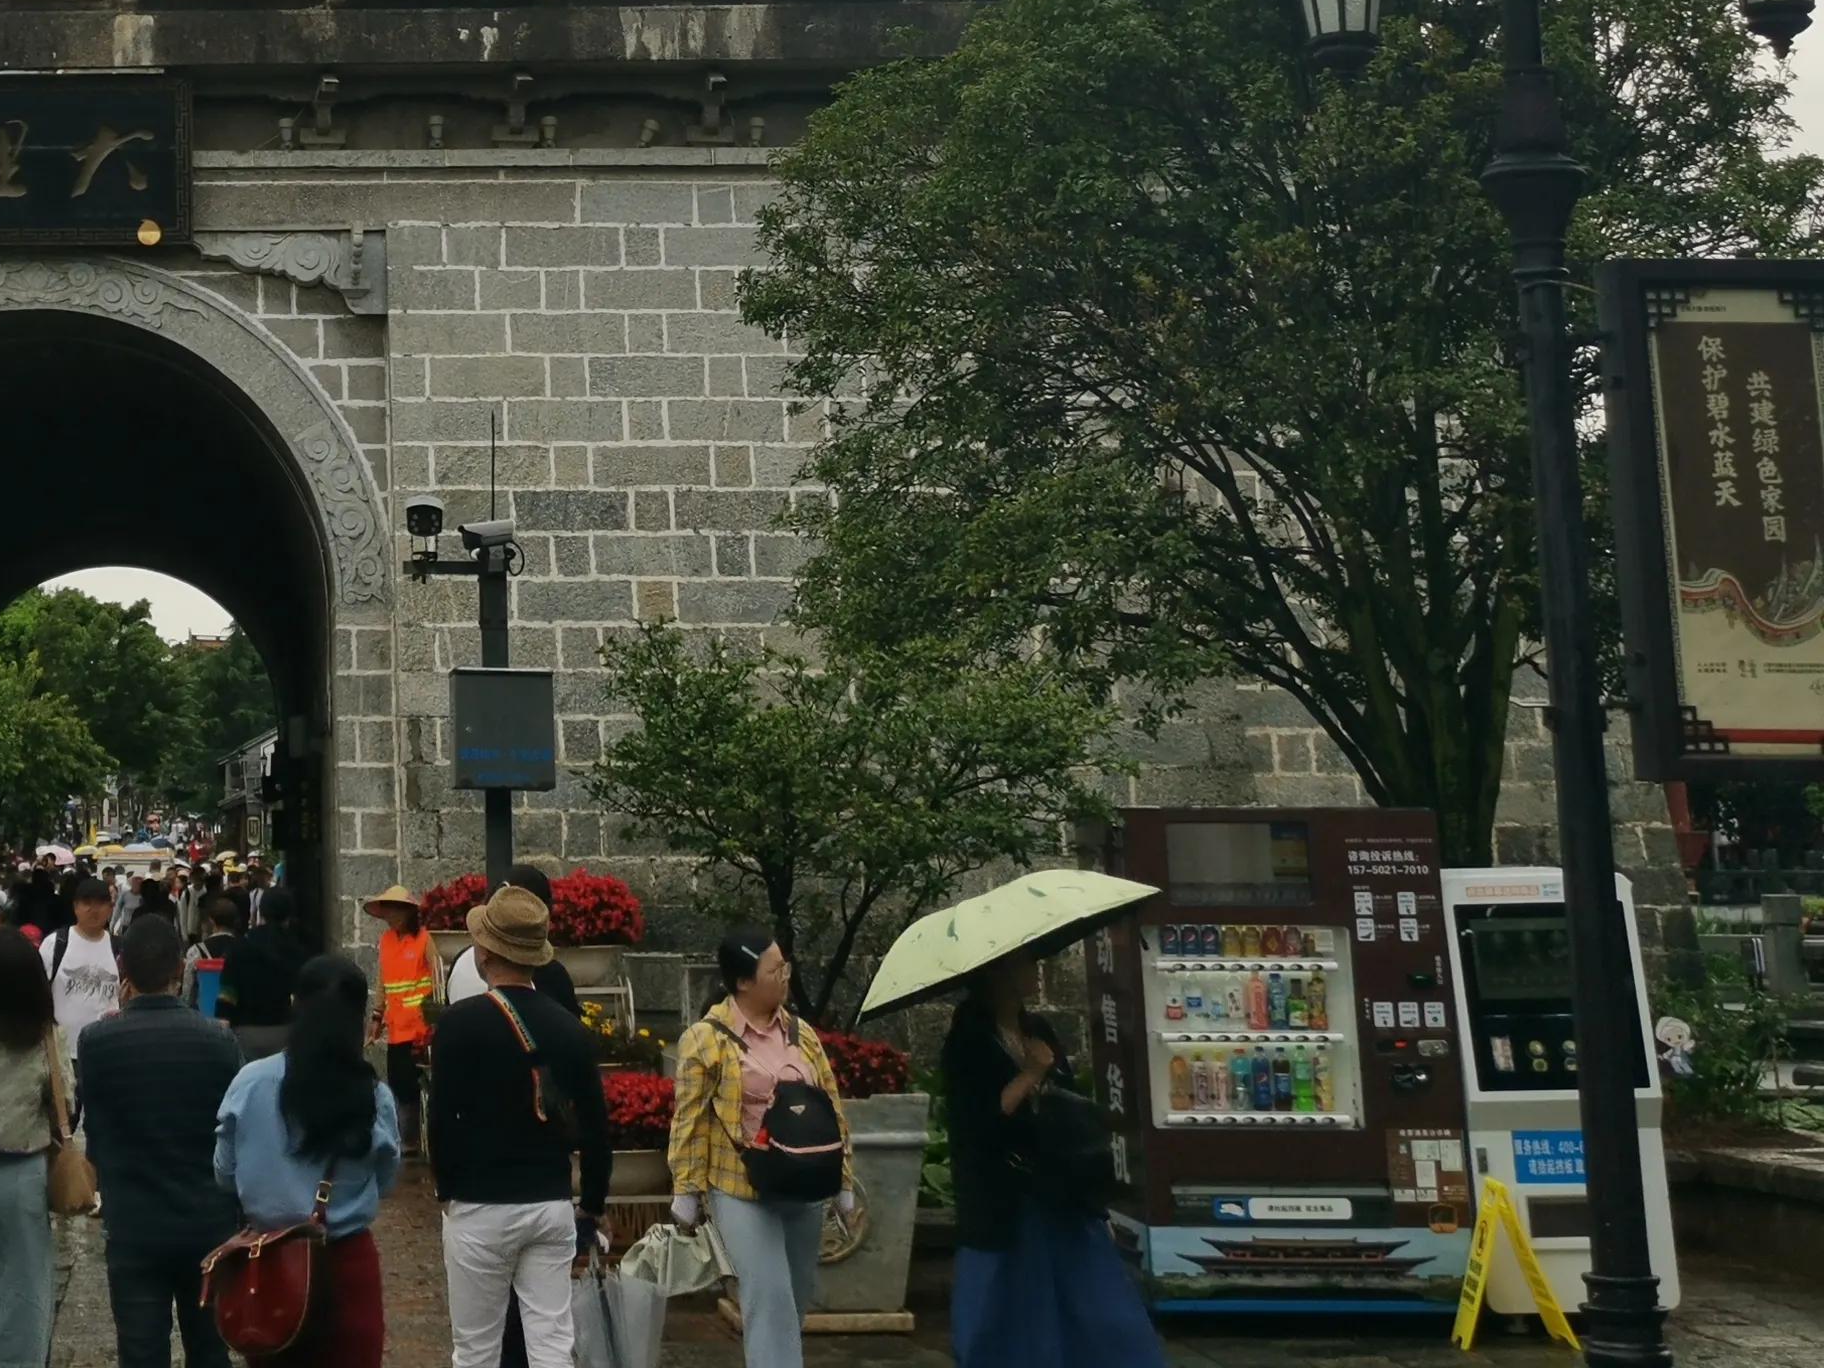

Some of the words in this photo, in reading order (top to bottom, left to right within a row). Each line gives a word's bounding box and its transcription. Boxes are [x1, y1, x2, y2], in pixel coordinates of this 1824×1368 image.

[1697, 335, 1743, 509] 保护碧水蓝天
[1746, 370, 1788, 544] 共建绿色家园
[1347, 864, 1429, 875] 157-5021-7010
